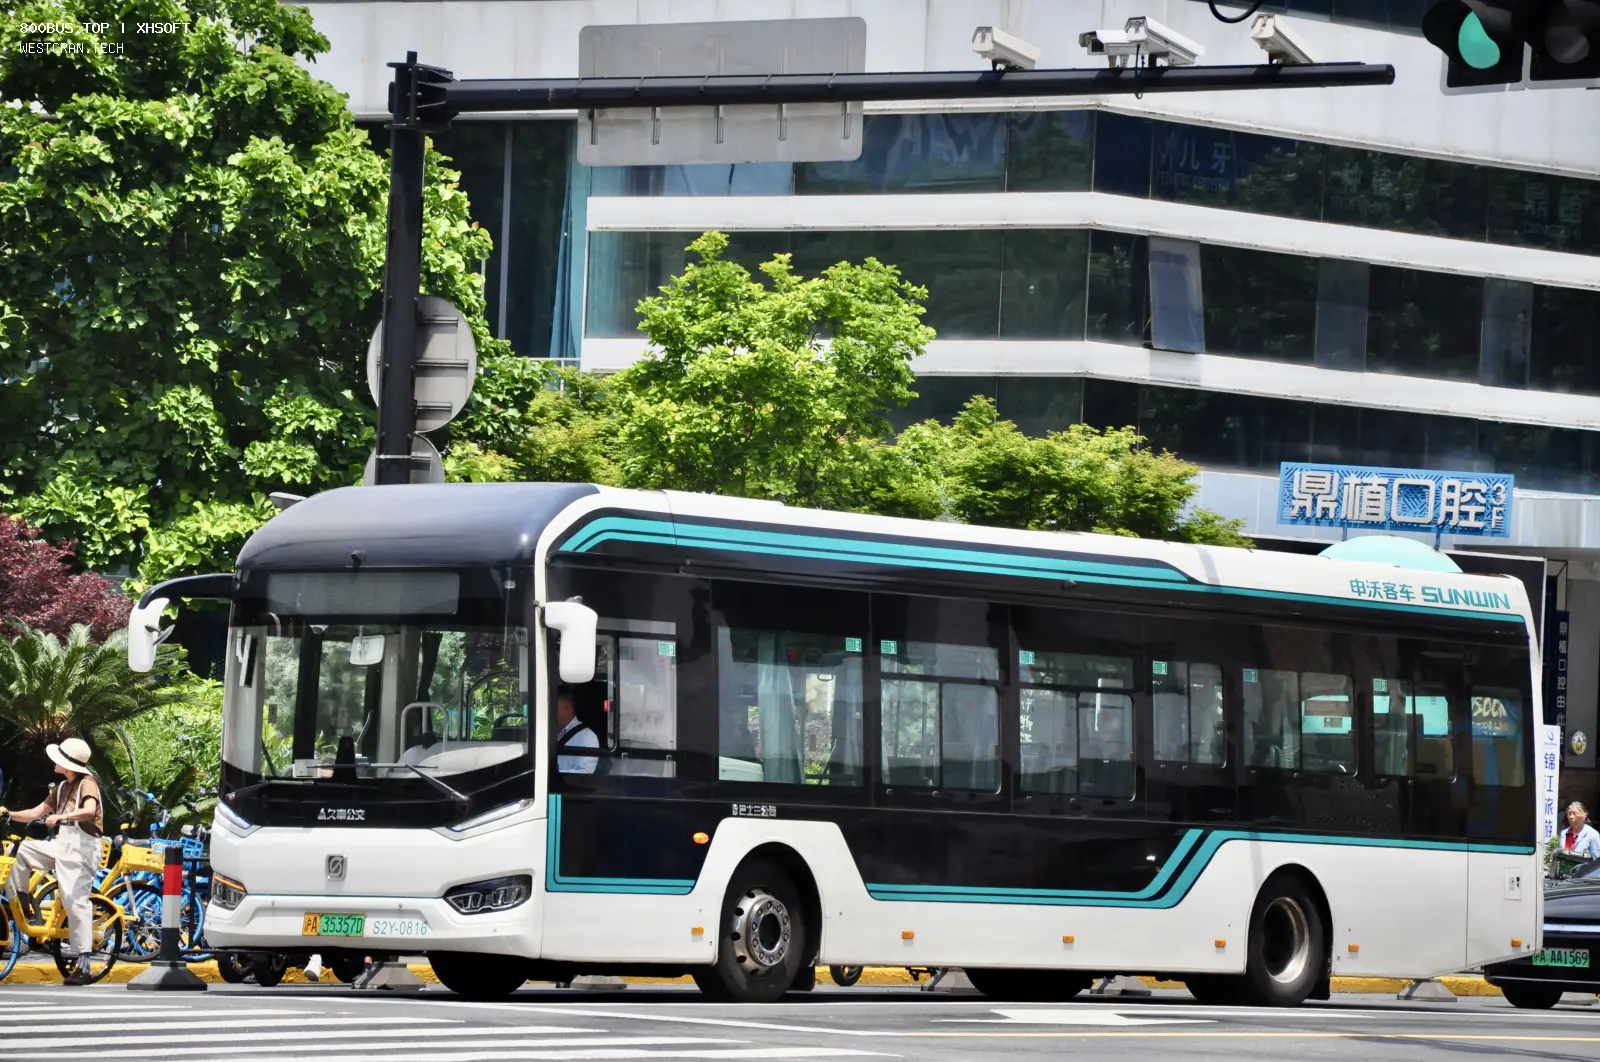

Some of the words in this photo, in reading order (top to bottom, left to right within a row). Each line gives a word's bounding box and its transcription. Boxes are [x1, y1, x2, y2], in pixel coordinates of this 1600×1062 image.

[1291, 470, 1487, 528] 鼎植口腔
[1491, 483, 1506, 530] 3F
[1350, 578, 1416, 602] 申沃客车
[1421, 585, 1511, 610] SUNWIN
[322, 916, 363, 933] 35357D
[373, 920, 428, 935] S2Y-0816
[1551, 951, 1588, 966] AA1569
